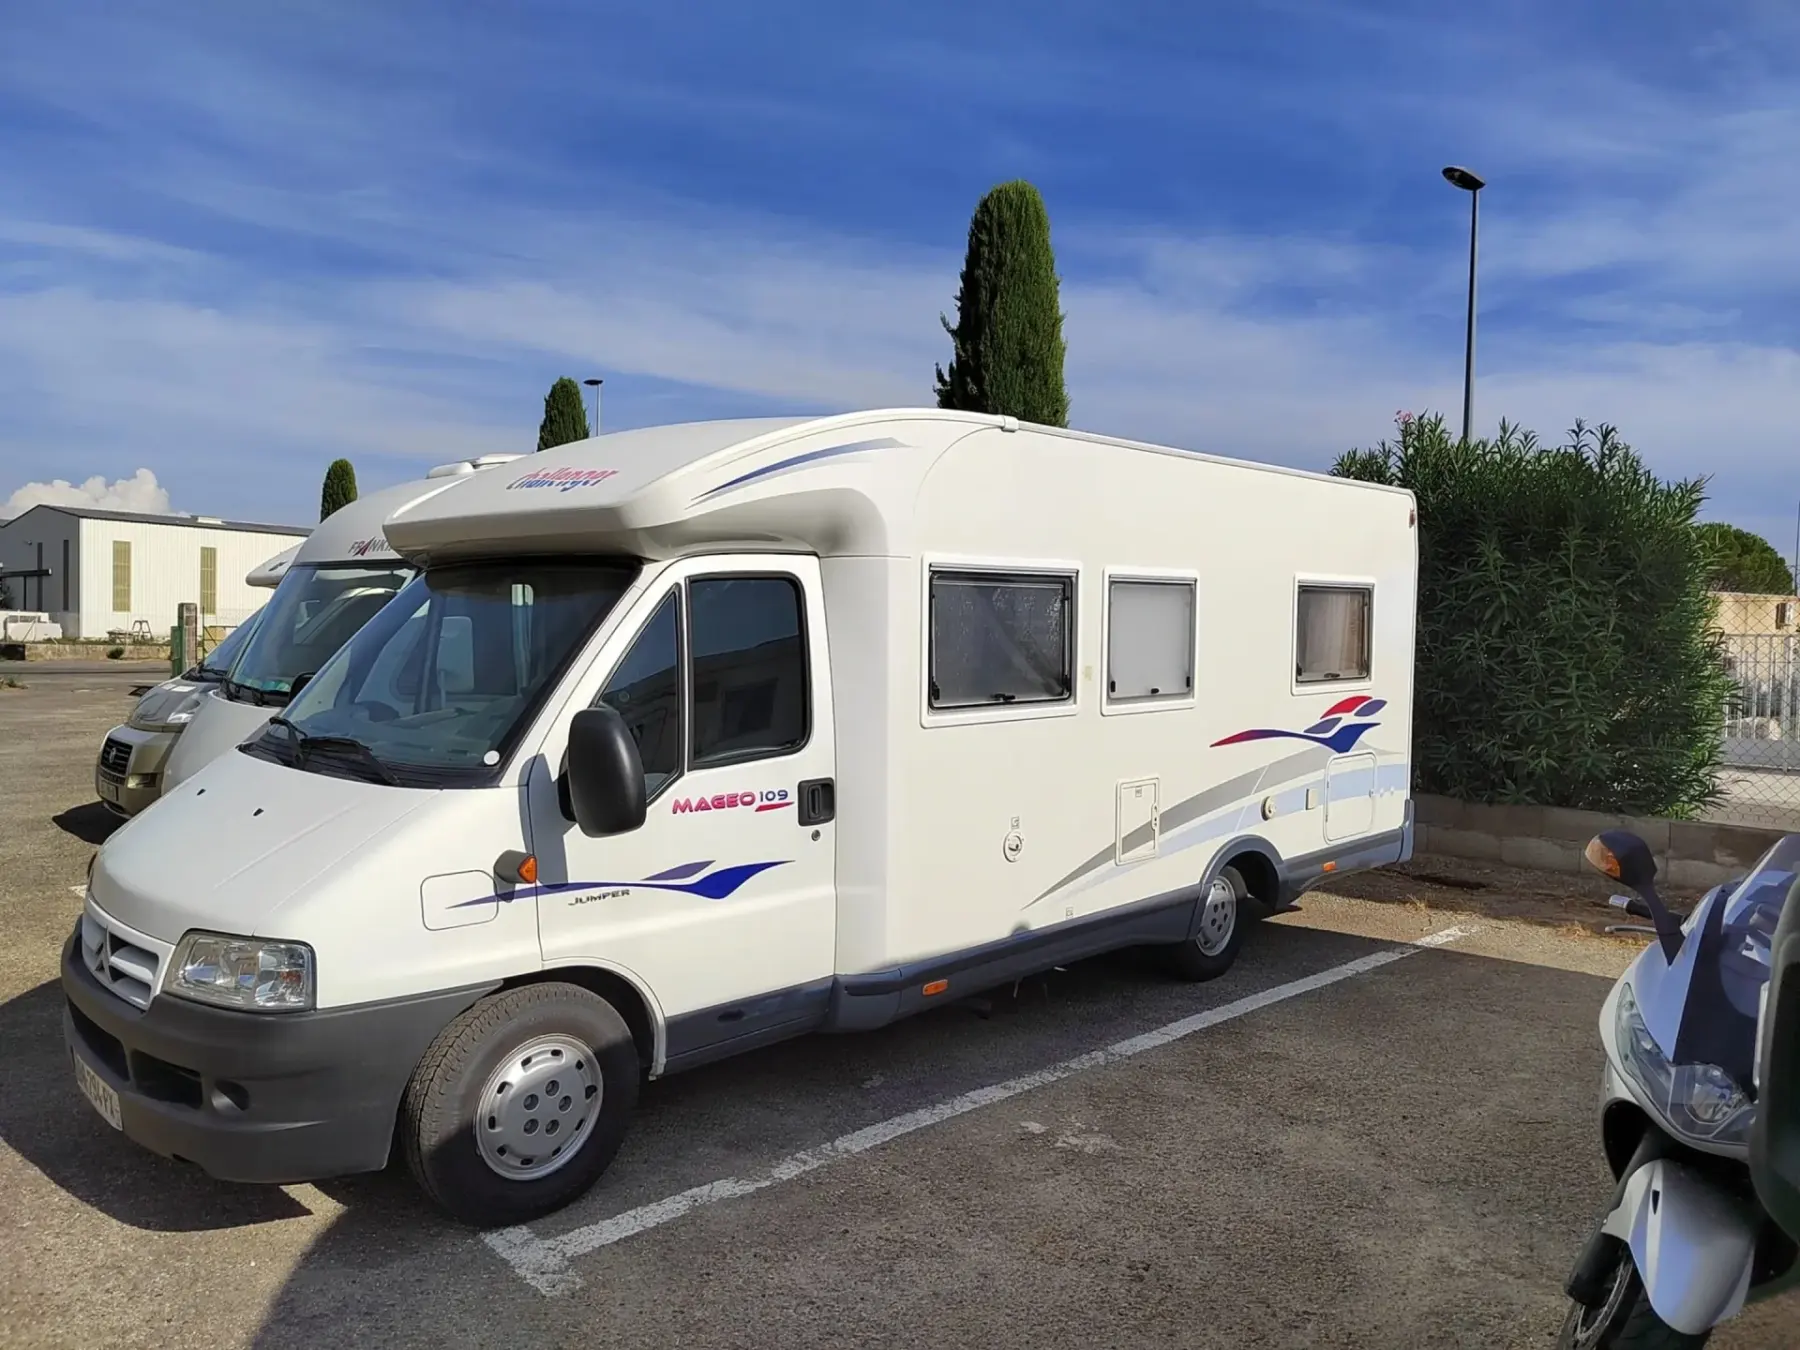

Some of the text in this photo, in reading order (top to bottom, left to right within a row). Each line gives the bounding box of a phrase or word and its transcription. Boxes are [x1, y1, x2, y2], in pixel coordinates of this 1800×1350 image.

[672, 789, 789, 814] MAGEO 109
[568, 889, 630, 906] JUMPER
